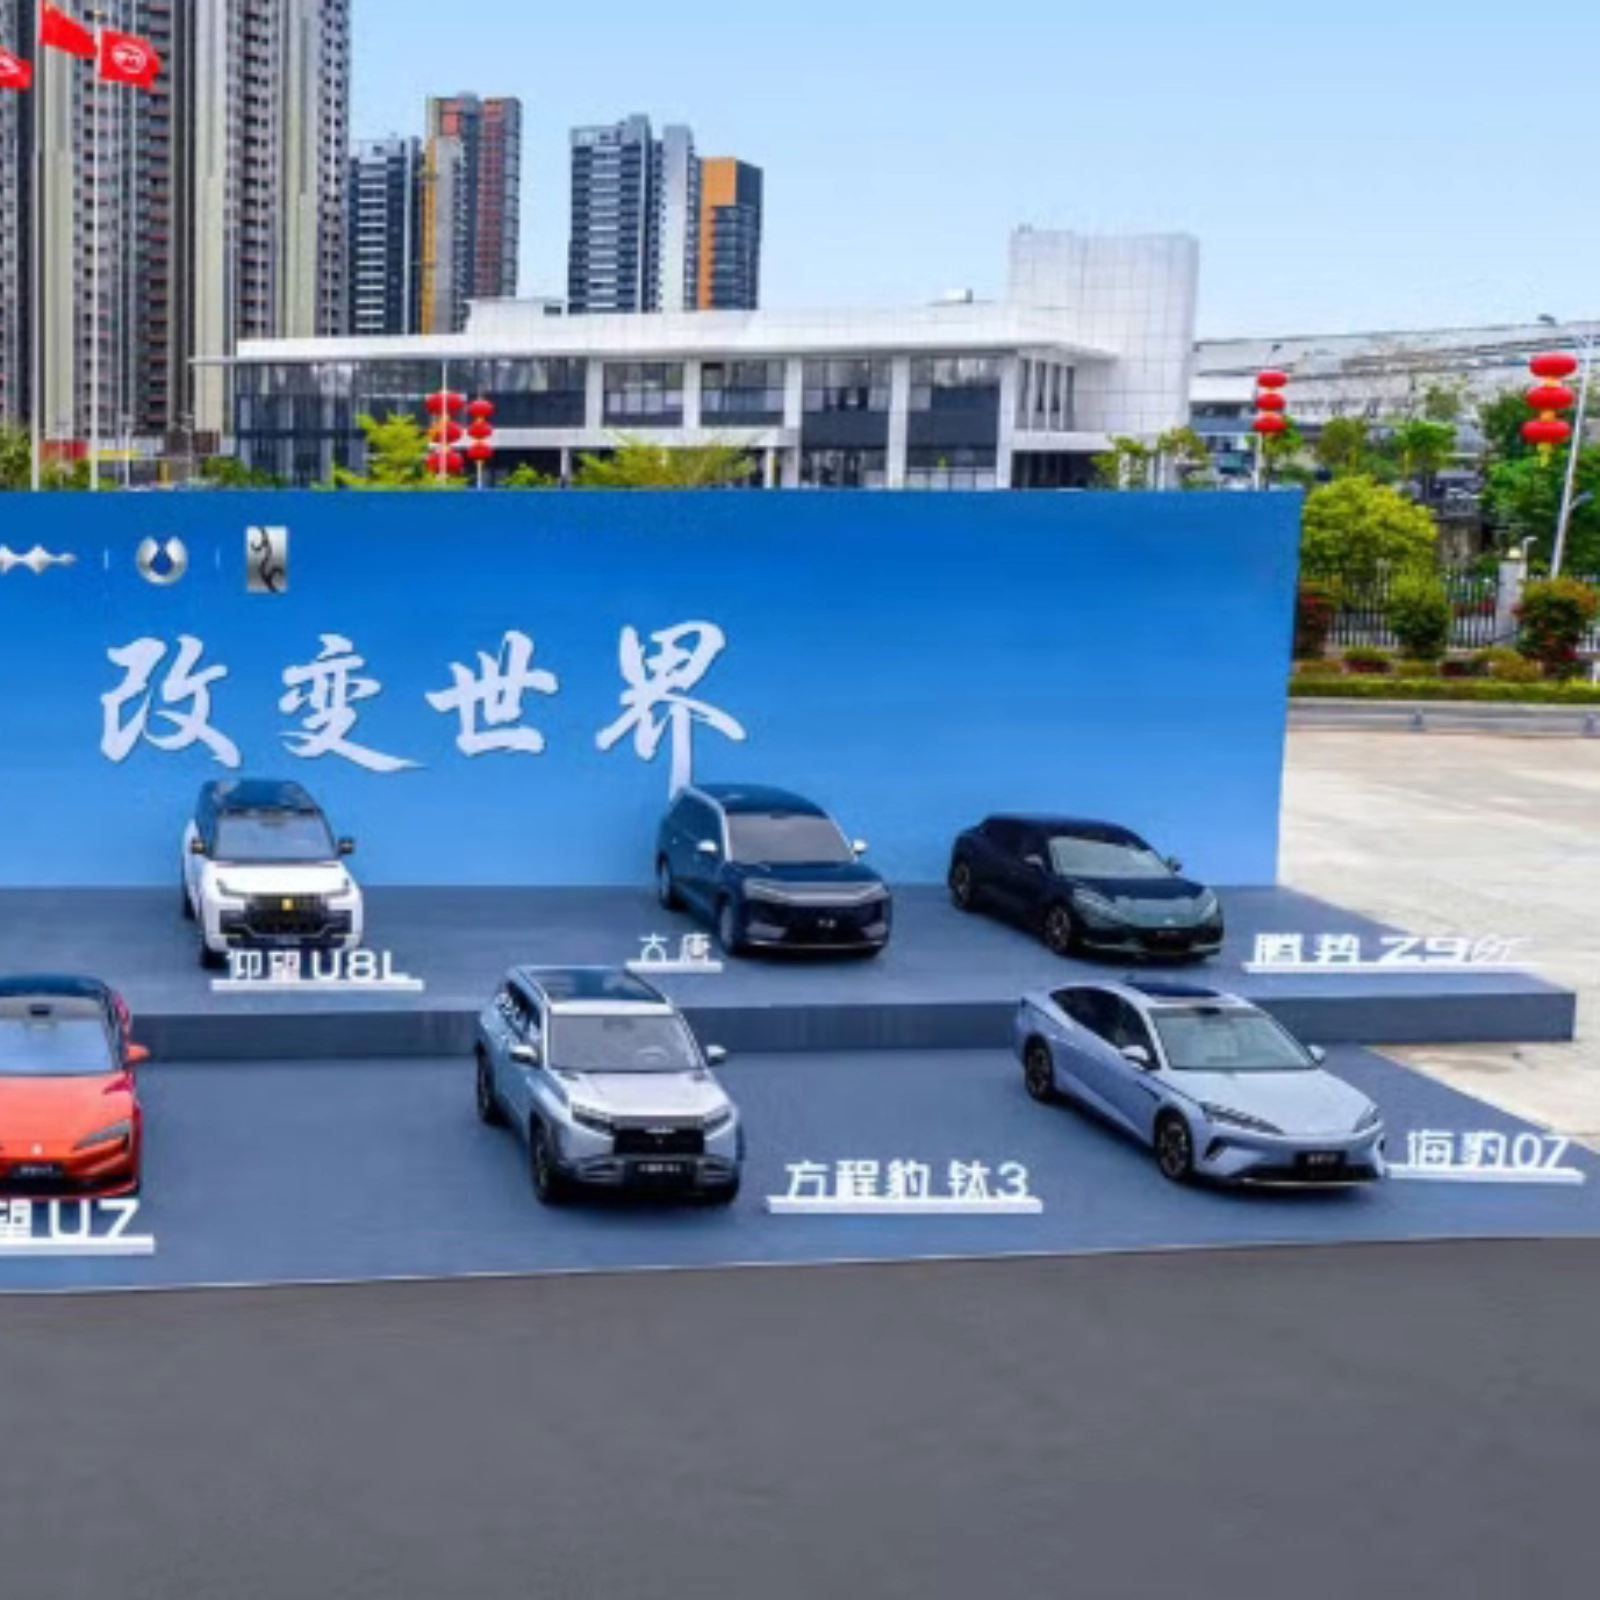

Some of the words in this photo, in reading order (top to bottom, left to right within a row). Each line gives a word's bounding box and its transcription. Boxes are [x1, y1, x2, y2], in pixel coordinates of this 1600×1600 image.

[98, 618, 746, 790] 改变世界
[311, 950, 410, 980] U8L
[1407, 1128, 1570, 1169] 海豹07
[785, 1160, 931, 1199] 方程豹
[948, 1160, 1027, 1199] 钛3
[50, 1199, 140, 1239] U7
